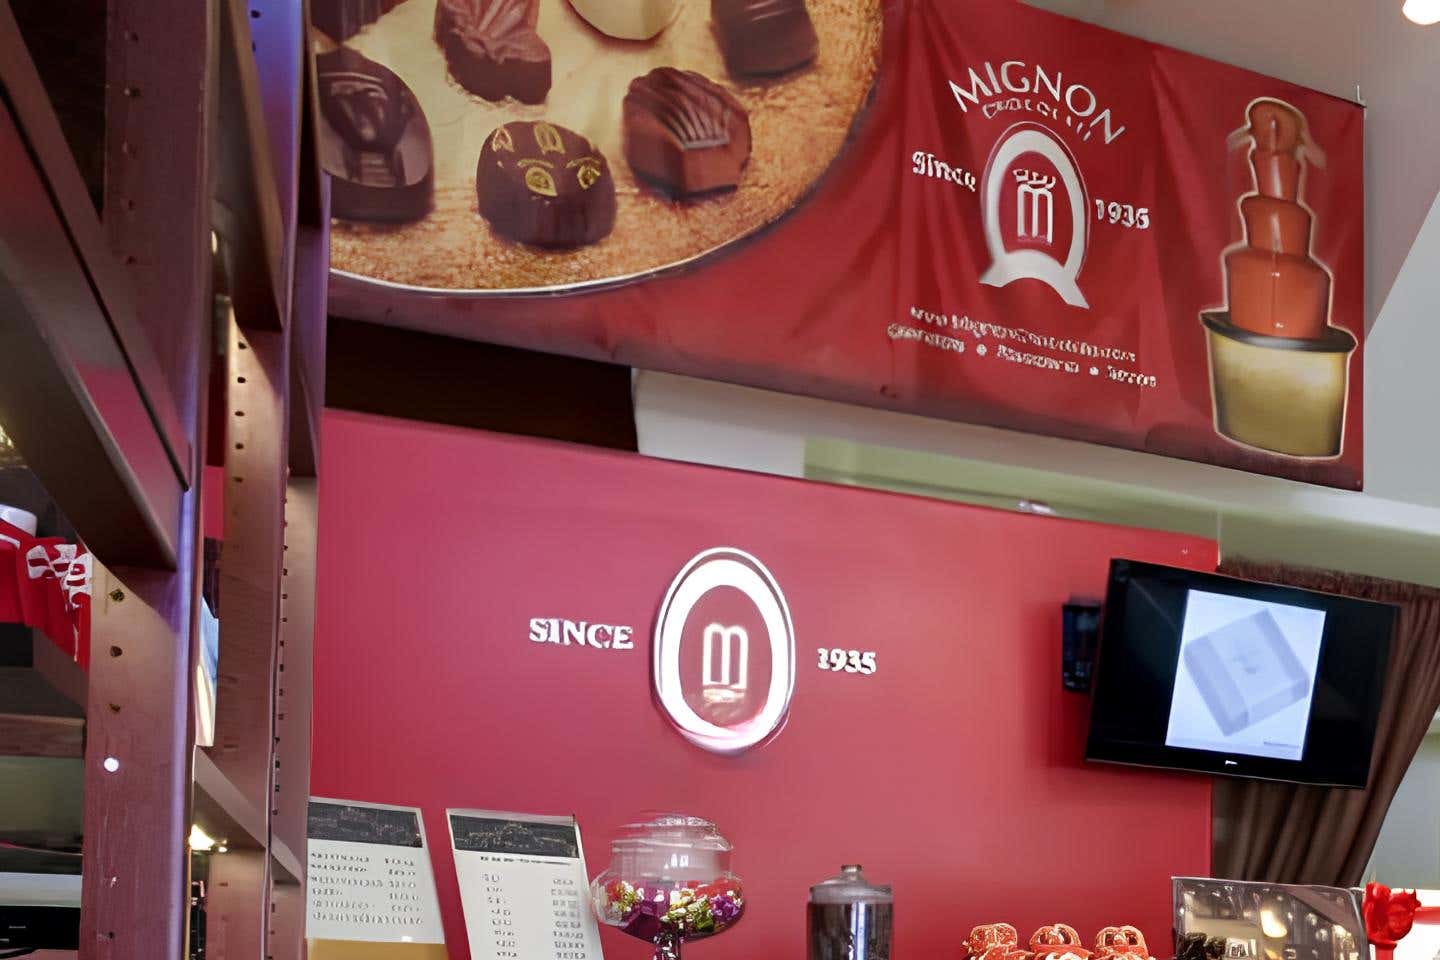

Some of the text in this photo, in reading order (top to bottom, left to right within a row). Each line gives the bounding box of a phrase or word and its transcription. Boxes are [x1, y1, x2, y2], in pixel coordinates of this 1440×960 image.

[949, 61, 1126, 144] MIGNON
[529, 617, 634, 650] SINCE
[817, 647, 877, 674] 1935
